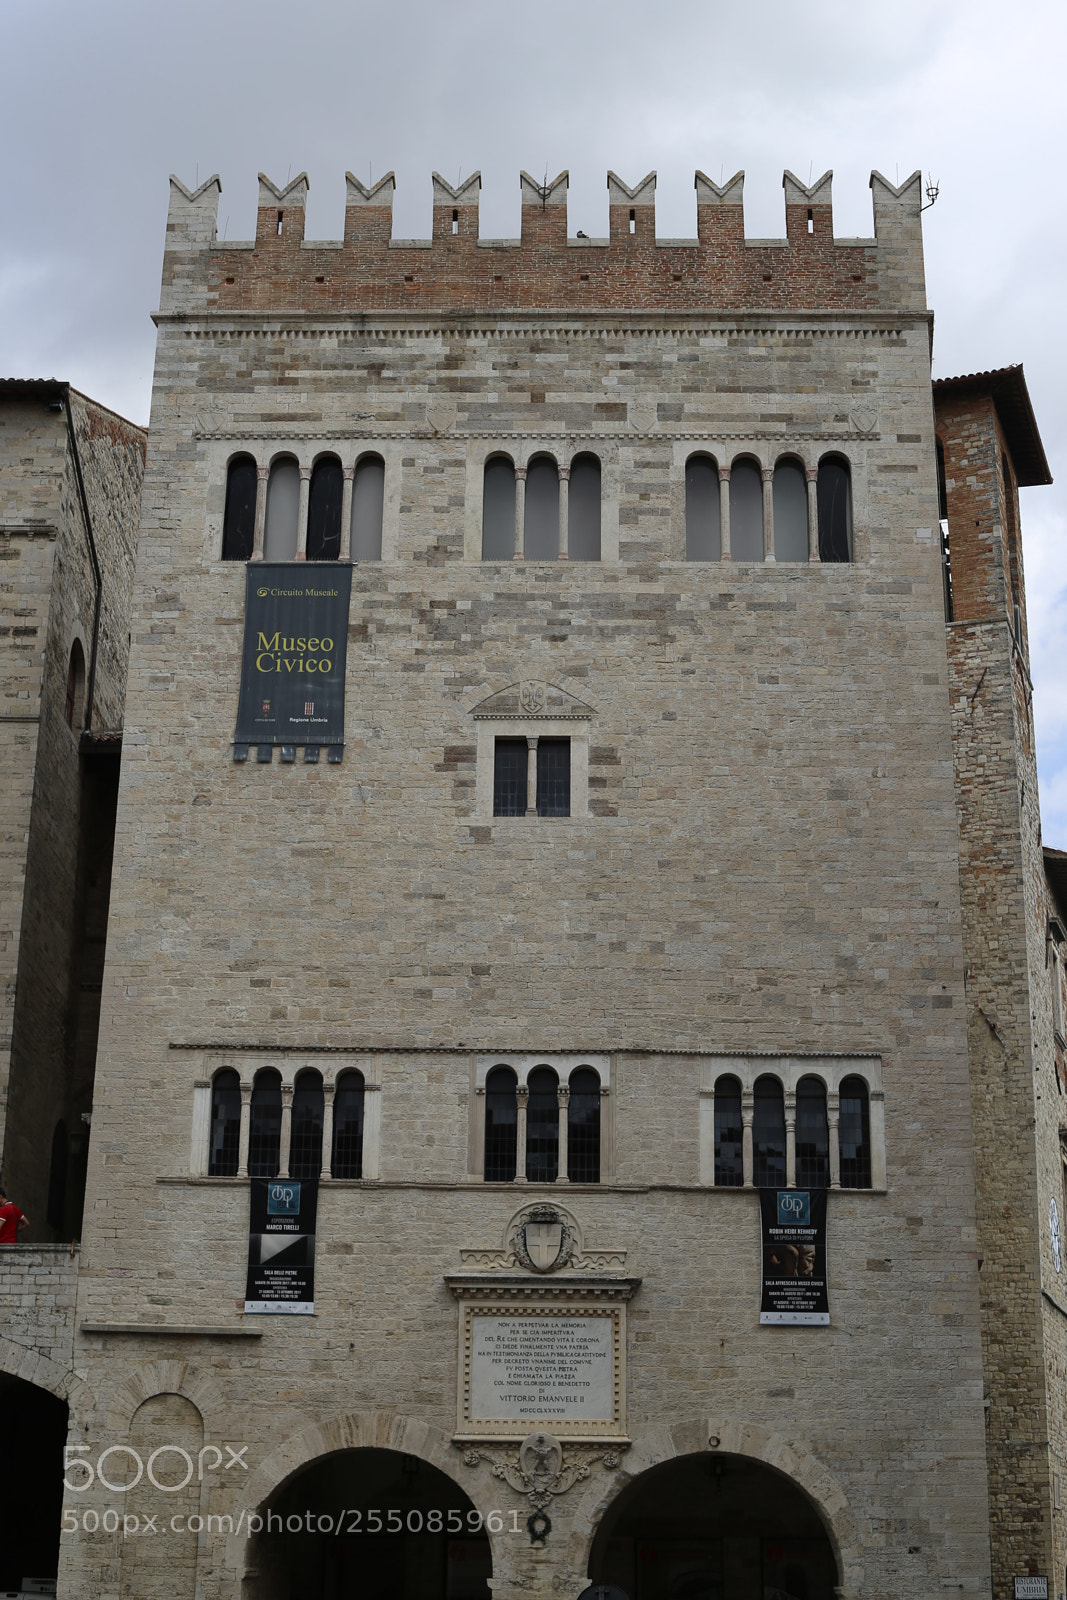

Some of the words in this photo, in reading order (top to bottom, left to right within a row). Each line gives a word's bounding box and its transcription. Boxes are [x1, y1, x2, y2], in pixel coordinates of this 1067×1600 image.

[270, 588, 303, 597] Circuito
[305, 588, 339, 597] Museale
[256, 631, 334, 652] Museo
[256, 652, 332, 673] Civico
